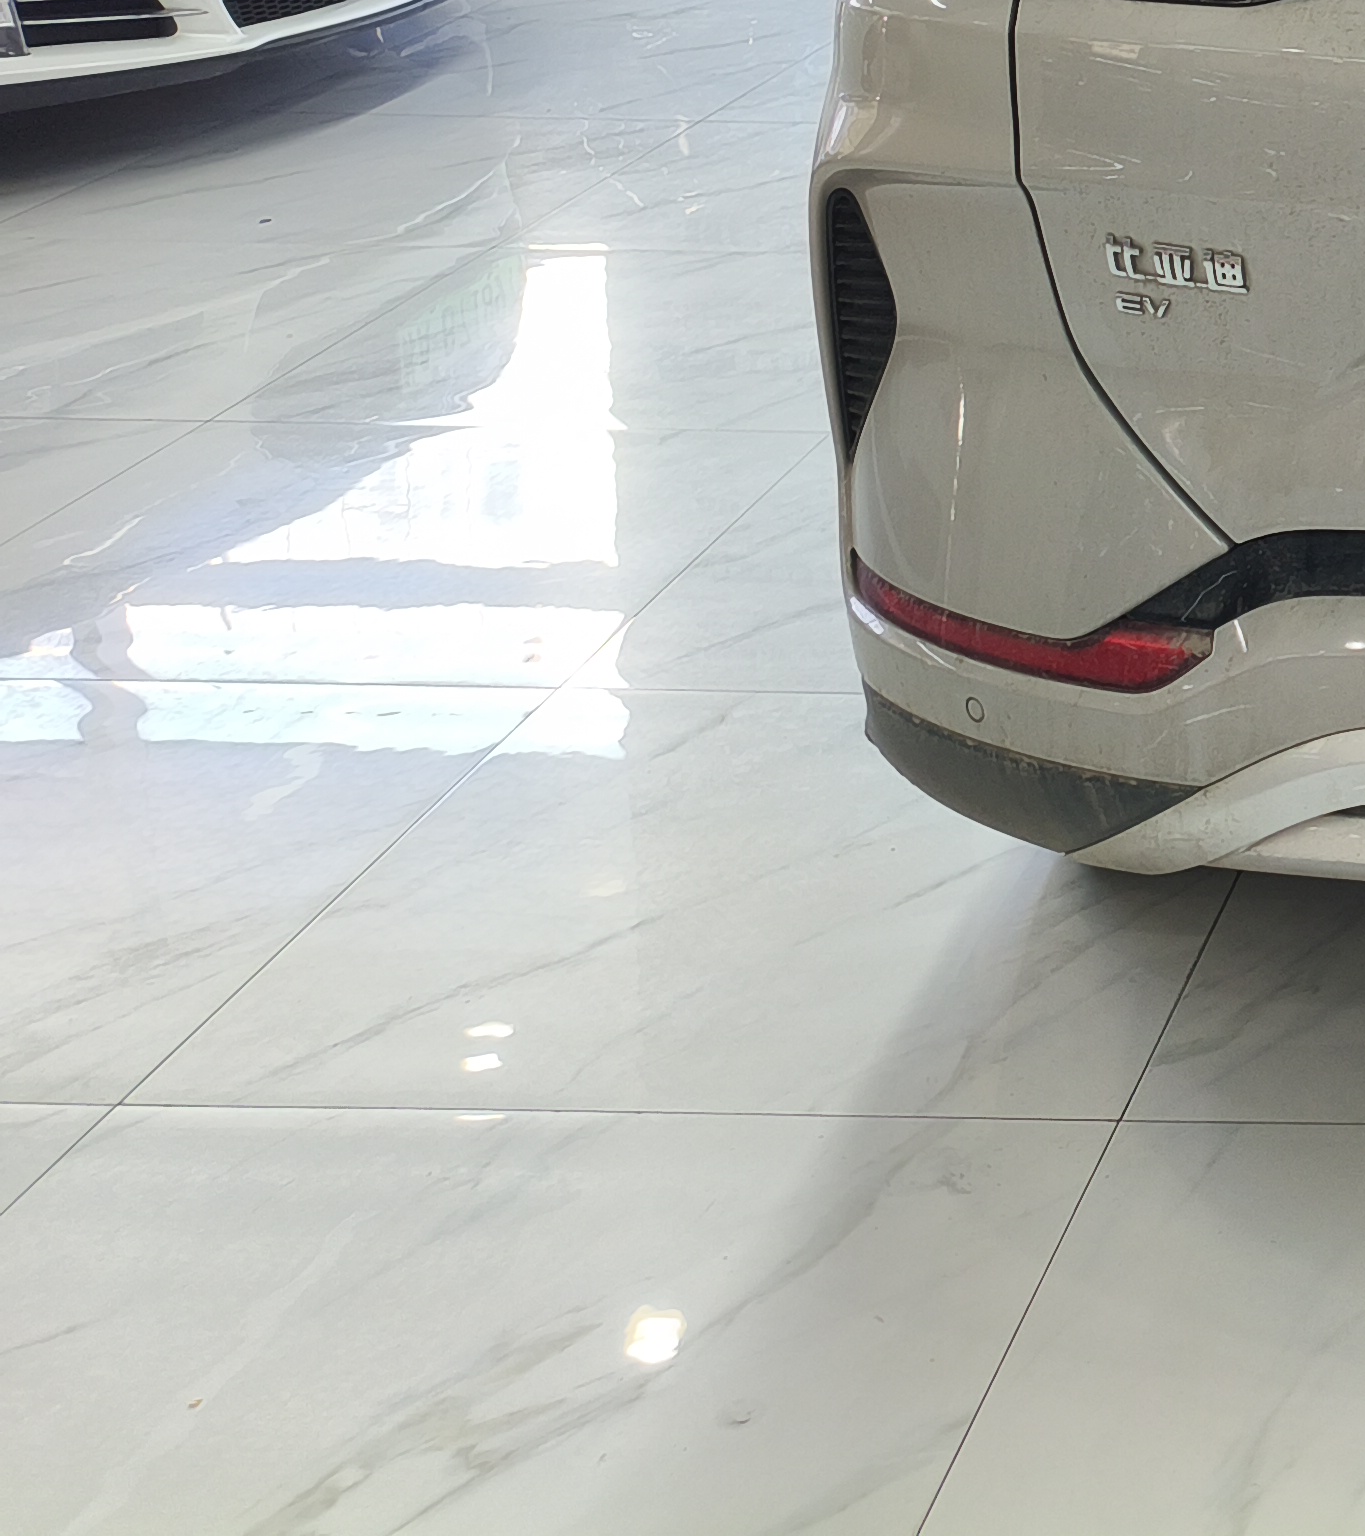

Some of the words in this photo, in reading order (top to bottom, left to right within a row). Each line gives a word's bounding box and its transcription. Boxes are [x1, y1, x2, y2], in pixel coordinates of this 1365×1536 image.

[1104, 231, 1250, 295] 比亚迪
[1114, 290, 1172, 319] EV
